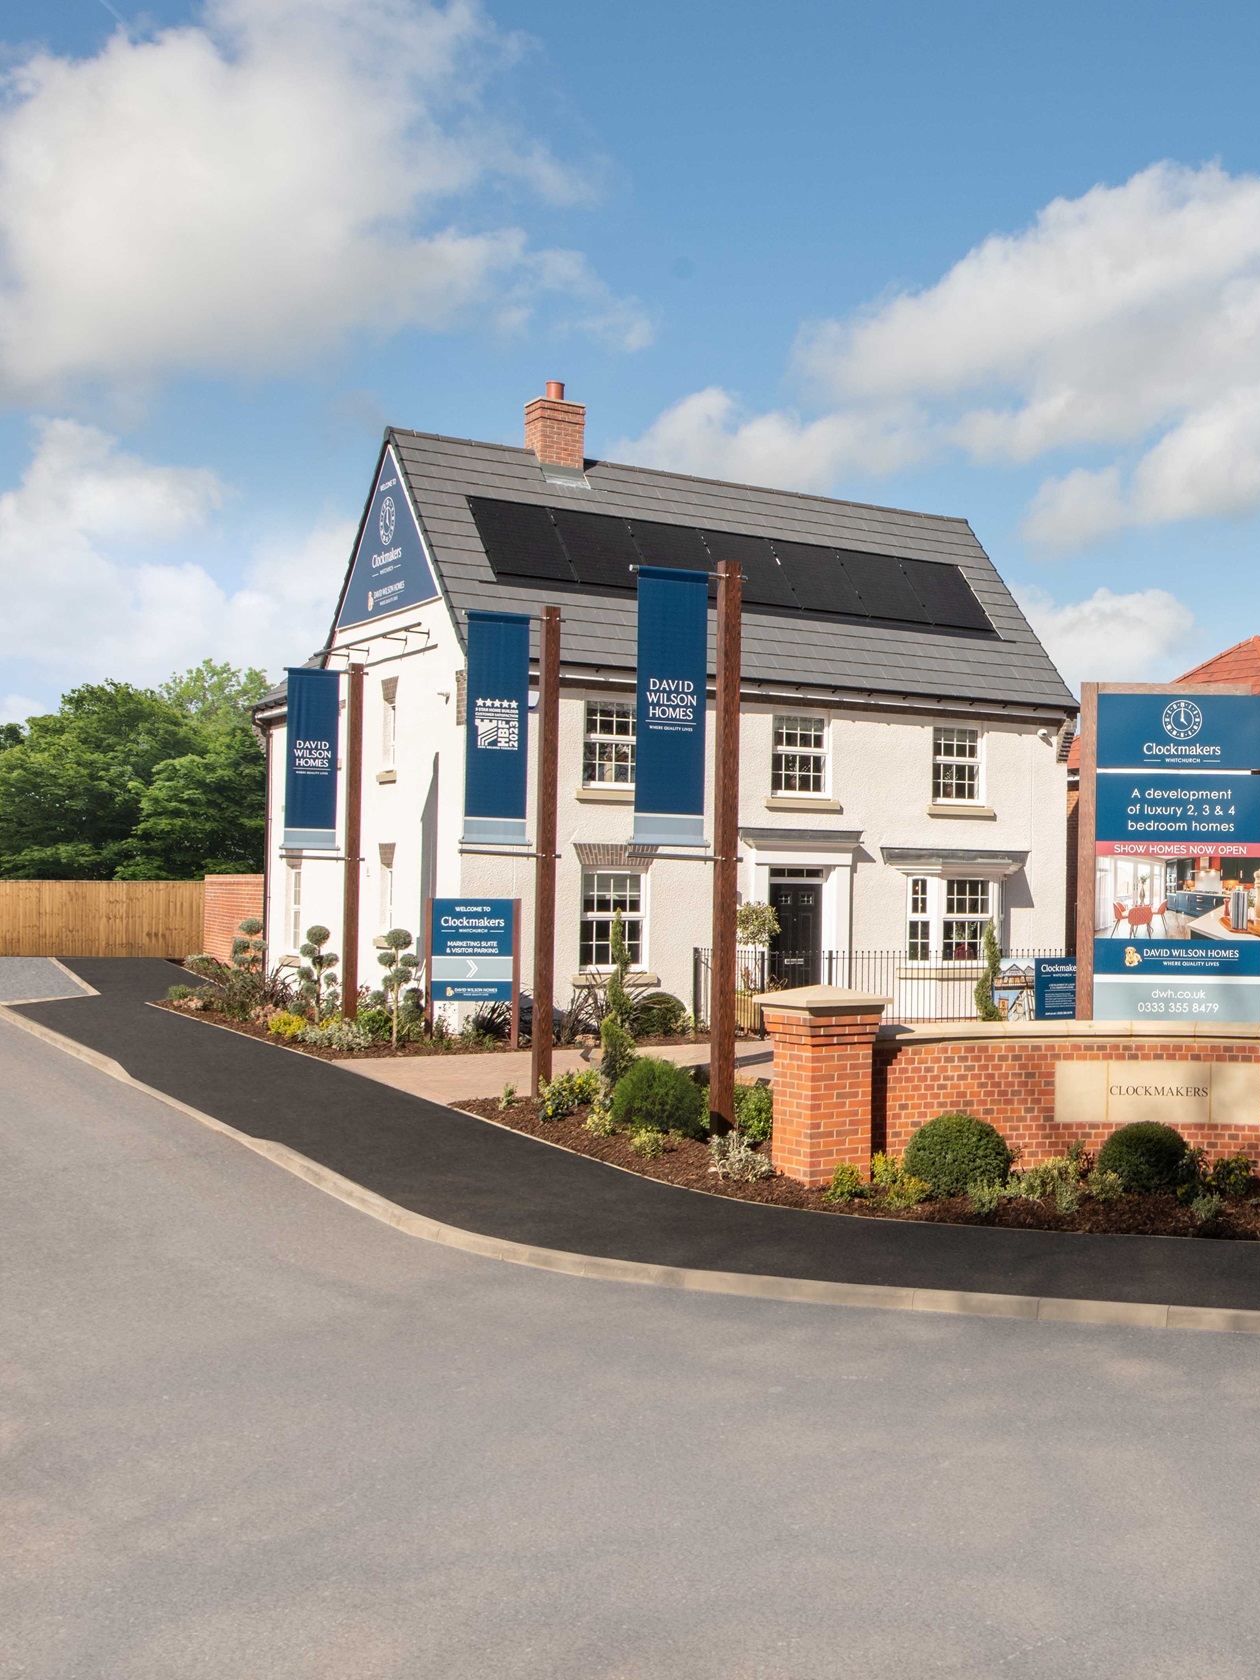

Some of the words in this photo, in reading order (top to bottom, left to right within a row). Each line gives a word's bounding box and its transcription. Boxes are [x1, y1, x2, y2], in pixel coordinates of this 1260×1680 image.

[372, 547, 402, 568] Clockmakers
[650, 678, 694, 692] DAVID
[646, 692, 697, 706] WILSON
[649, 706, 694, 720] HOMES
[498, 720, 509, 747] HBF
[509, 721, 519, 748] 2023
[296, 740, 329, 749] DAVID
[1143, 742, 1220, 755] Clockmakers
[294, 749, 331, 758] WILSON
[296, 758, 329, 767] HOMES
[1131, 788, 1140, 798] A
[1145, 788, 1232, 801] development
[1127, 804, 1140, 814] of
[1144, 804, 1183, 817] luxury
[1187, 805, 1198, 816] 2,
[1202, 805, 1210, 816] 3
[1214, 806, 1224, 816] &
[1228, 806, 1236, 816] 4
[1128, 820, 1188, 831] bedroom
[1192, 821, 1234, 832] homes
[1114, 844, 1147, 854] SHOW
[1149, 845, 1187, 854] HOMES
[1189, 846, 1216, 854] NOW
[1219, 846, 1247, 855] OPEN
[441, 916, 504, 926] Clockmakers
[1143, 949, 1170, 957] DAVID
[1171, 949, 1206, 957] WILSON
[1208, 950, 1239, 958] HOMES
[1041, 964, 1076, 972] Clockmake
[1151, 989, 1206, 999] dwh.co.uk
[1137, 1002, 1165, 1012] 0333
[1168, 1002, 1189, 1013] 355
[1192, 1003, 1219, 1013] 8479
[1109, 1085, 1208, 1097] CLOCKMAKERS
